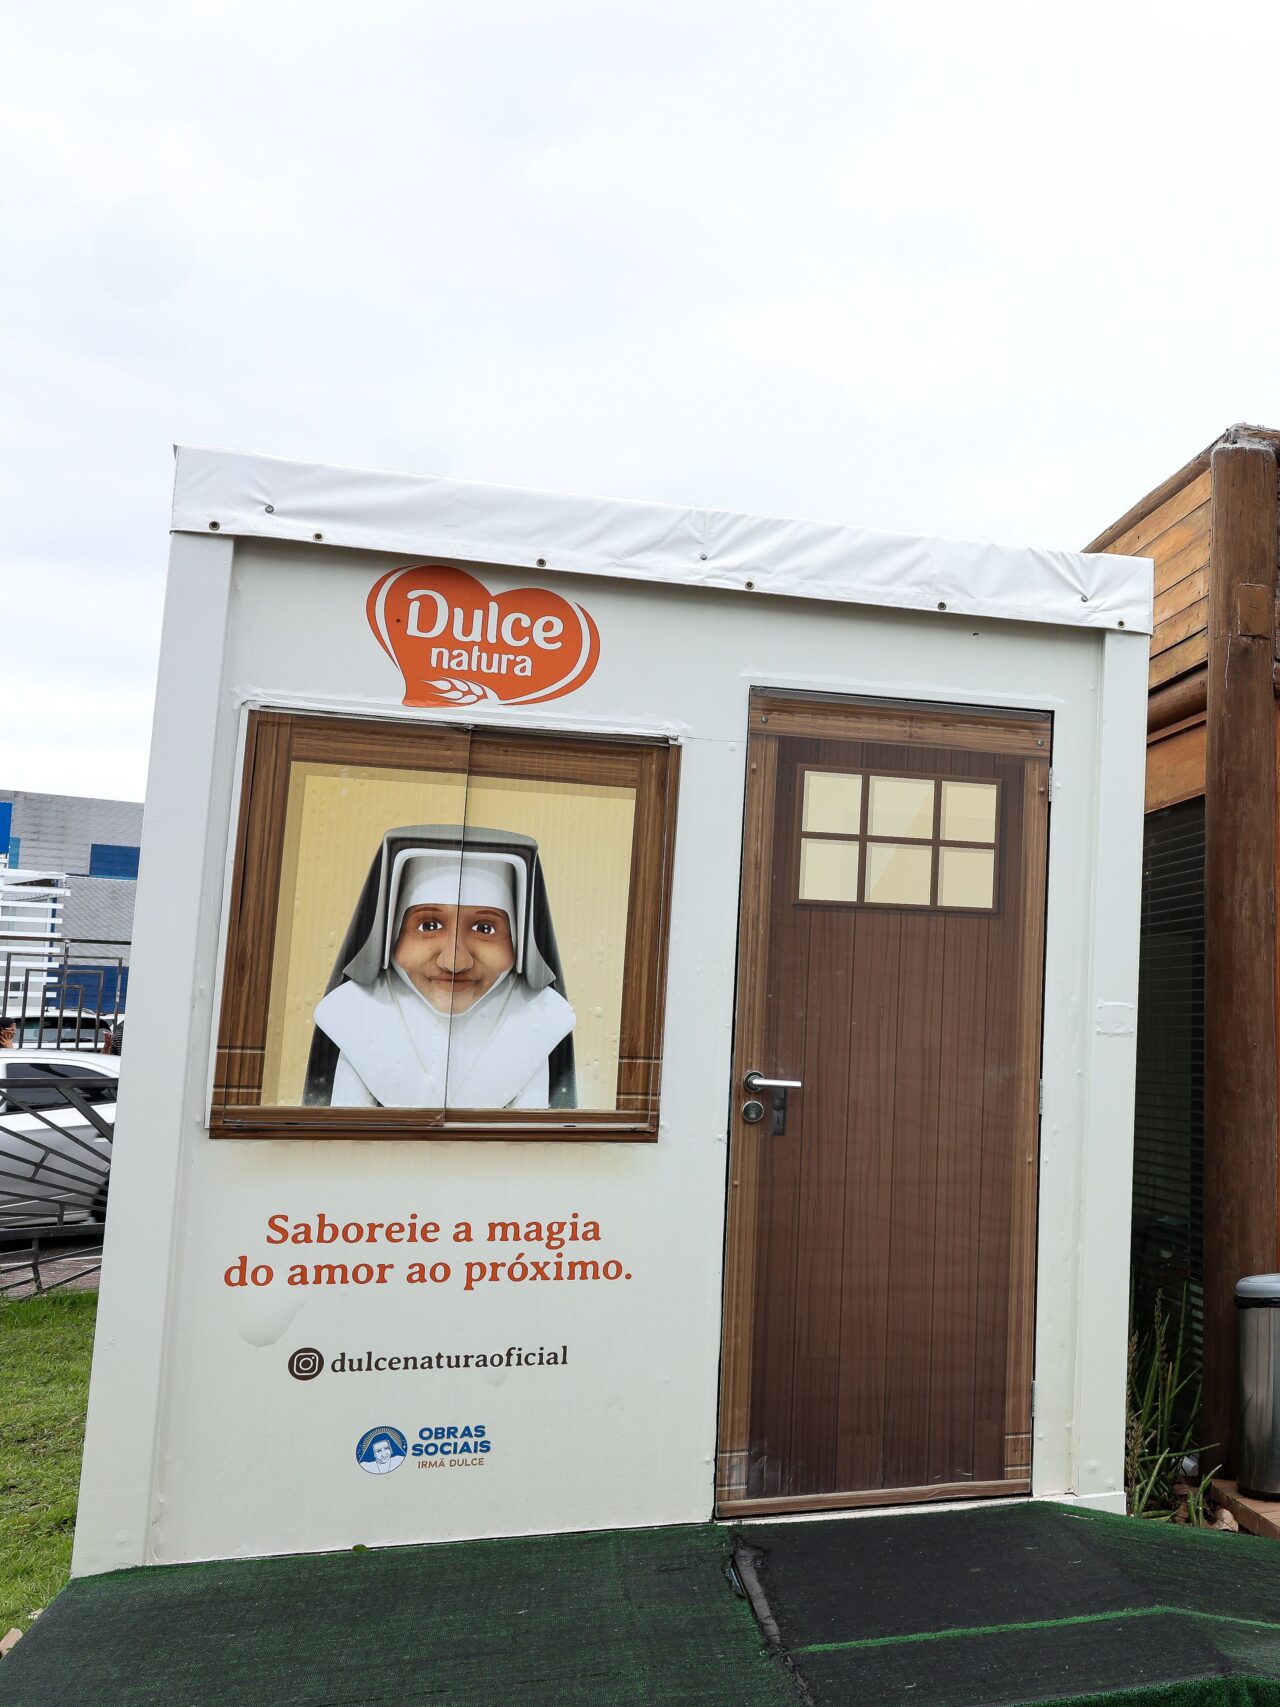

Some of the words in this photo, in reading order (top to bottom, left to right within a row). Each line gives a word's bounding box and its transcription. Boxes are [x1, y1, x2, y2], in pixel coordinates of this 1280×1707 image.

[406, 589, 564, 650] Dulce
[430, 645, 532, 677] natura
[266, 1212, 440, 1245] Saboreie
[452, 1219, 473, 1243] a
[486, 1212, 602, 1251] magia
[223, 1255, 274, 1287] do
[287, 1261, 394, 1286] amor
[406, 1260, 451, 1284] ao
[463, 1252, 633, 1291] próximo.
[330, 1345, 569, 1374] dulcenaturaoficial
[419, 1424, 486, 1441] OBRAS
[411, 1440, 491, 1457] SOCIAIS
[418, 1458, 446, 1469] IRMÃ
[449, 1457, 485, 1467] DULCE
